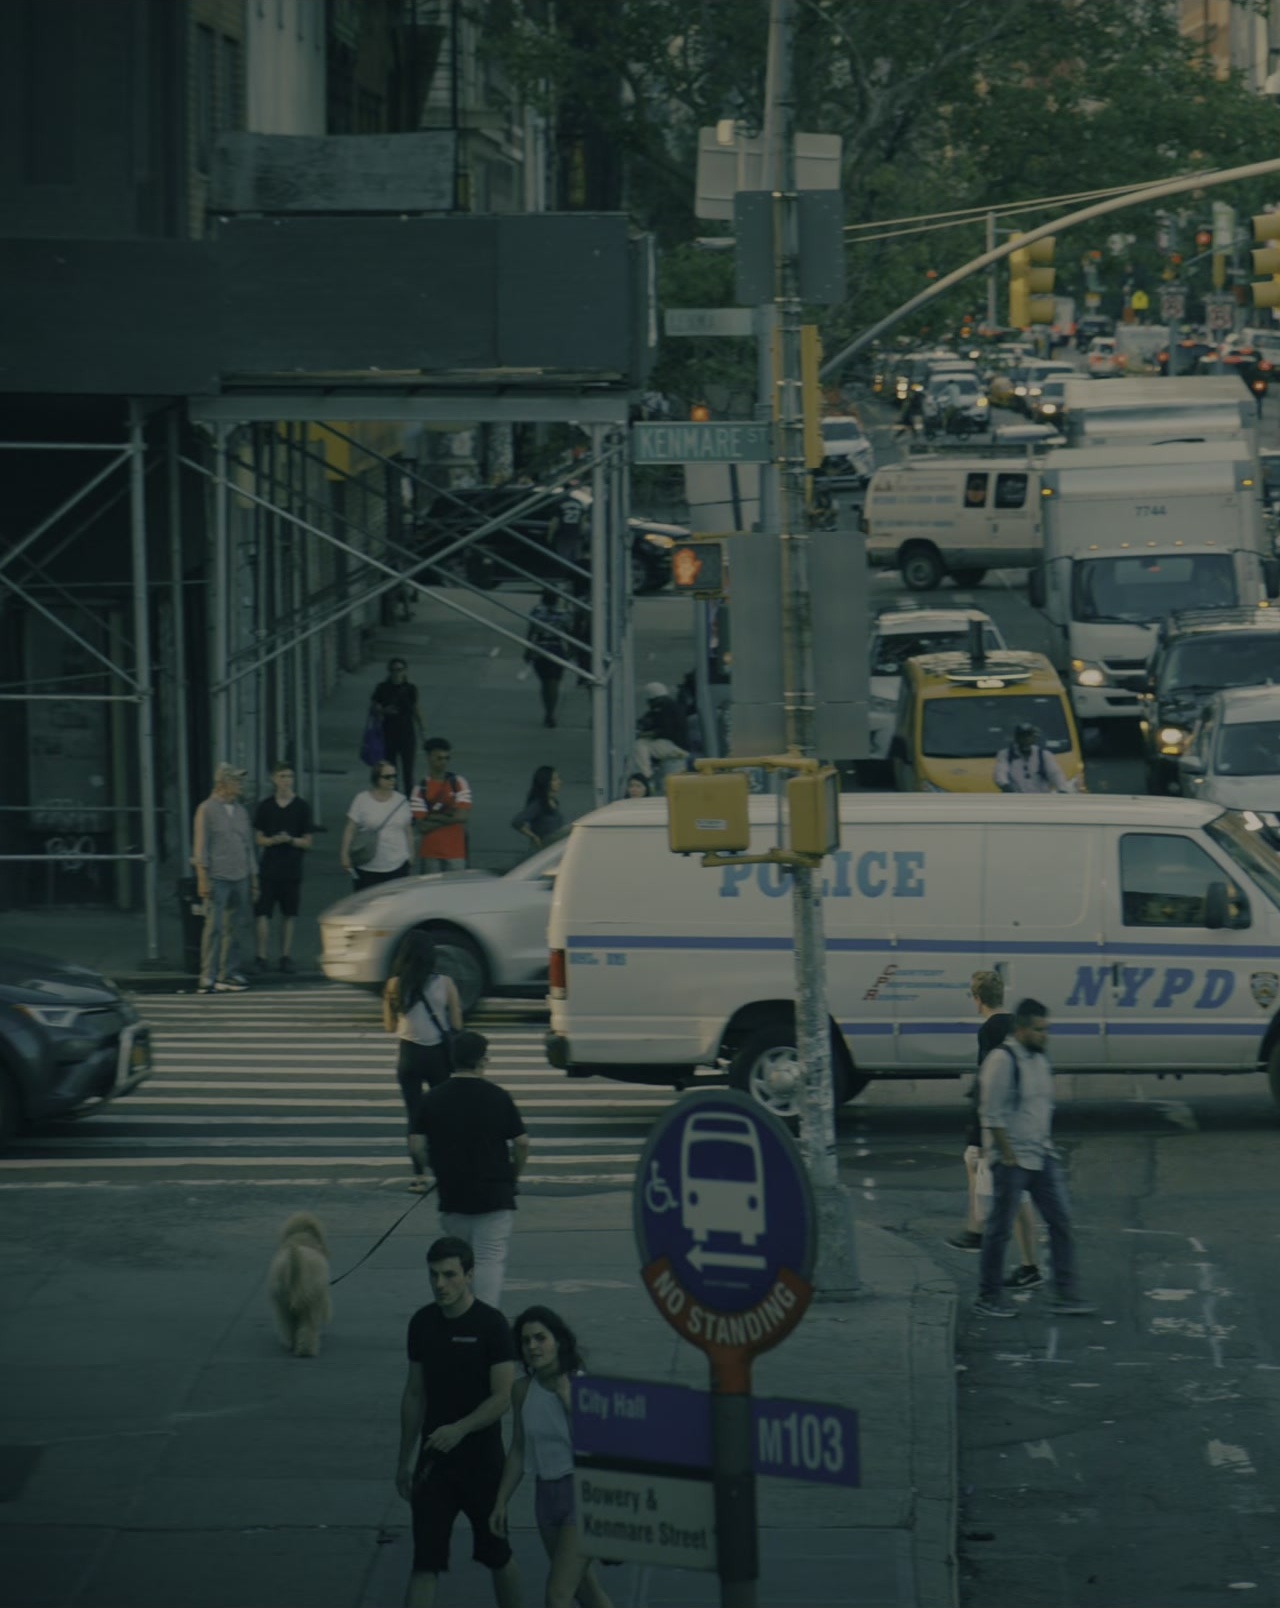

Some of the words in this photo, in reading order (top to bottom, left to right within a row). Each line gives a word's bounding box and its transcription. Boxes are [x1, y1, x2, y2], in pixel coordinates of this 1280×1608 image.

[639, 427, 743, 459] KENMARE
[747, 427, 768, 444] ST
[719, 851, 925, 898] POICE
[1065, 966, 1236, 1009] NYPD
[653, 1270, 685, 1316] NO
[687, 1281, 798, 1347] STANDING
[578, 1387, 609, 1420] City
[613, 1392, 647, 1420] Hall
[757, 1412, 844, 1473] M103
[581, 1479, 640, 1513] Bowery
[645, 1487, 657, 1511] &
[584, 1516, 654, 1547] Kenmare
[657, 1521, 708, 1550] Street
